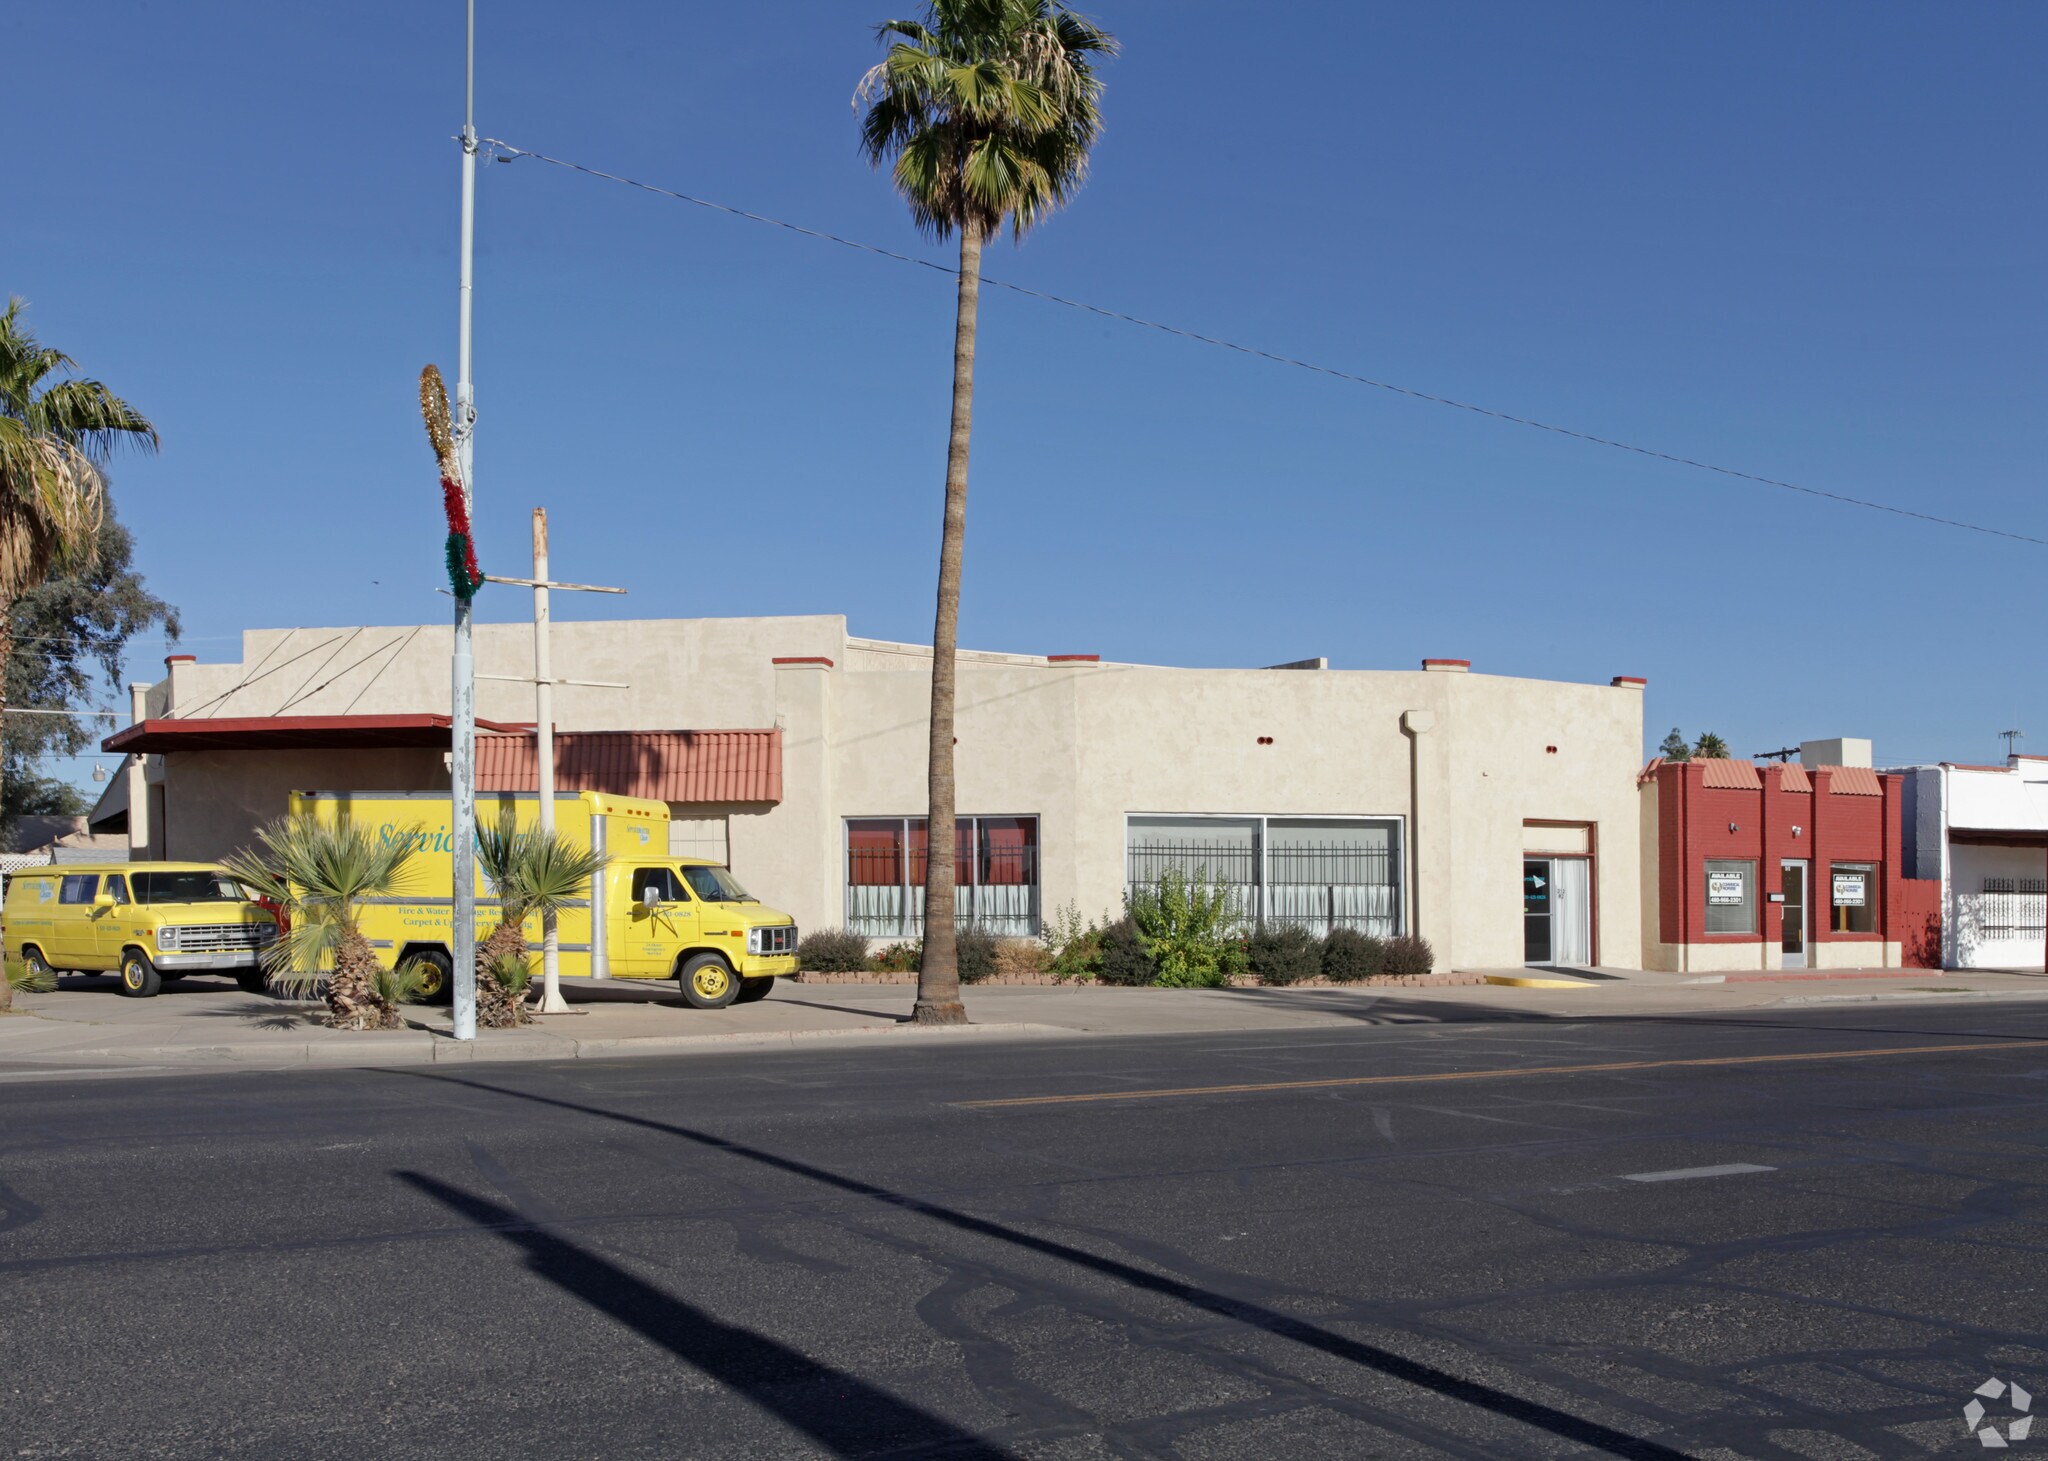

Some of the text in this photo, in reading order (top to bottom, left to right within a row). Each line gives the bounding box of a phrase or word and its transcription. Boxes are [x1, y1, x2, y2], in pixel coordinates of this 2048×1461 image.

[398, 907, 415, 915] Fire
[417, 907, 424, 915] &
[426, 907, 450, 915] Water
[403, 918, 432, 928] Carpet
